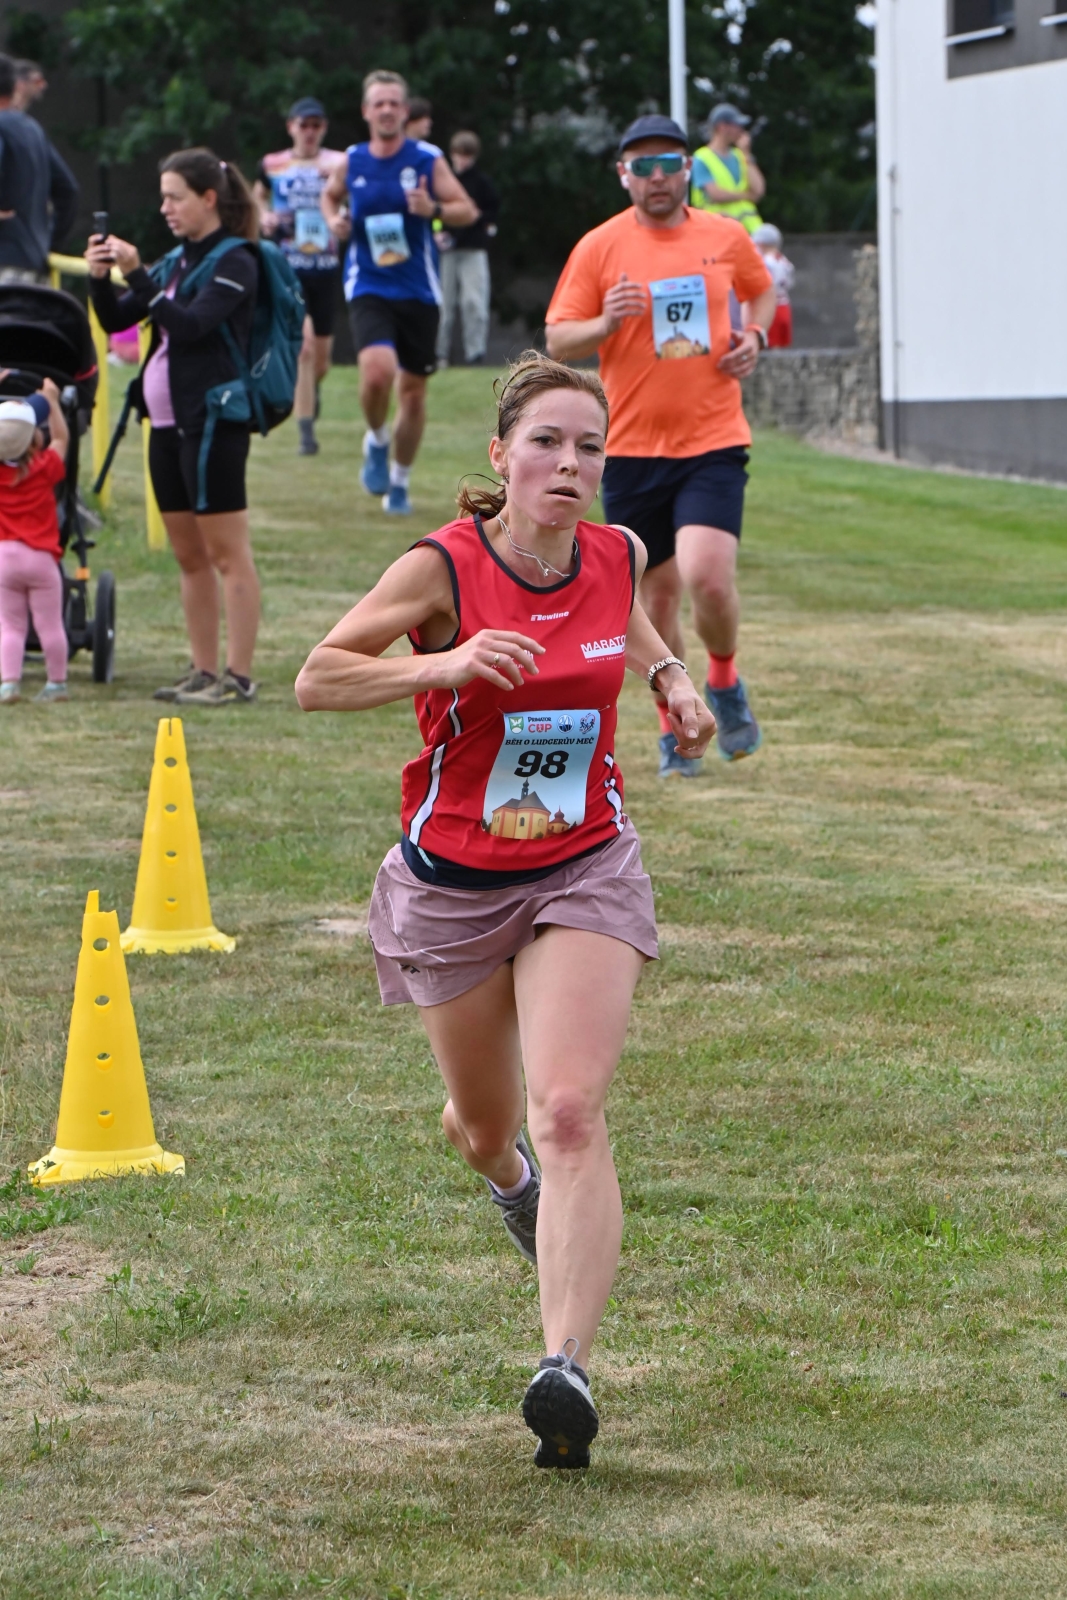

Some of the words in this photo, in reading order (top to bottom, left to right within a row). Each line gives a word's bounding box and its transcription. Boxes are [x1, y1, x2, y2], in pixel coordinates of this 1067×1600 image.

[666, 301, 693, 323] 67
[528, 723, 552, 733] CUP
[531, 737, 575, 745] LUDGERŮV
[576, 736, 594, 744] MEČ
[514, 750, 569, 778] 98
